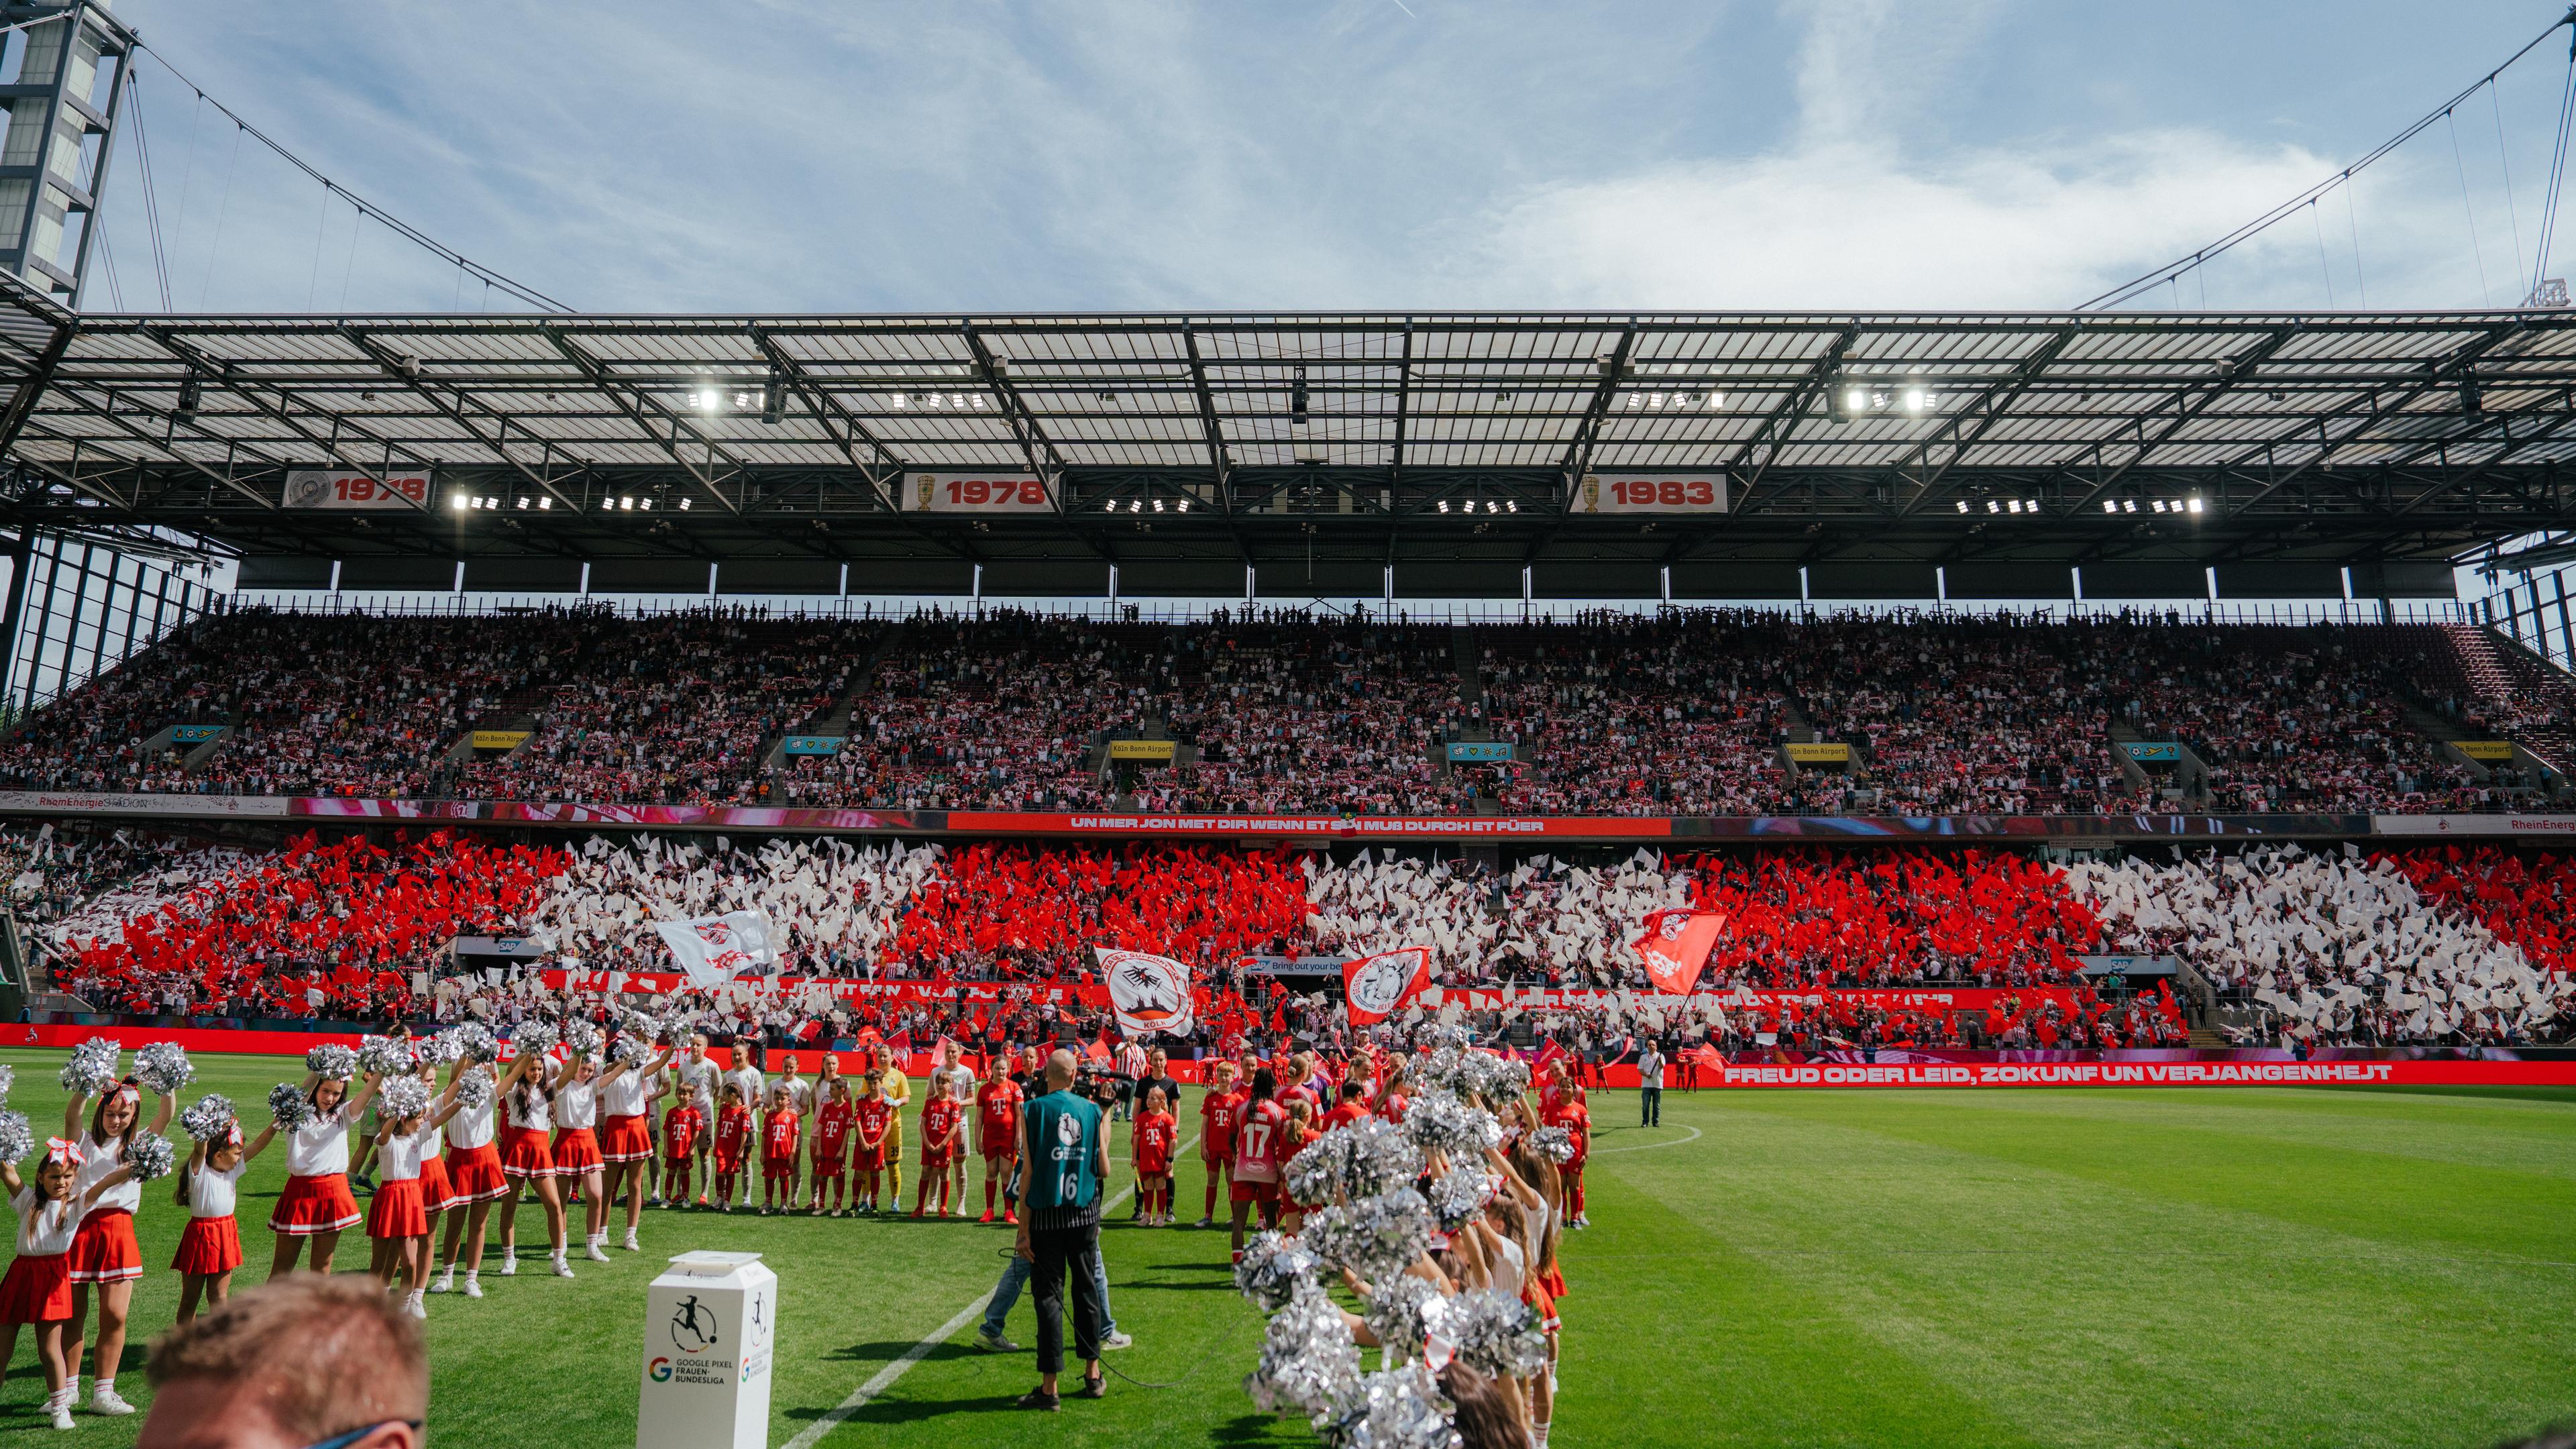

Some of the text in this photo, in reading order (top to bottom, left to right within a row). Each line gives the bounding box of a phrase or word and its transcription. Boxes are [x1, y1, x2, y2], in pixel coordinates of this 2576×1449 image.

[335, 478, 425, 500] 1978
[947, 481, 1046, 504] 1978
[1611, 482, 1714, 505] 1983
[1147, 745, 1173, 753] Airport
[1071, 818, 1097, 828] UN
[1099, 818, 1138, 828] MER
[1140, 818, 1176, 828] JON
[1178, 819, 1216, 829] MET
[1218, 819, 1248, 830] DIR
[1250, 820, 1304, 830] WENN
[1306, 820, 1329, 830] ET
[1330, 820, 1362, 830] SN
[1405, 821, 1470, 831] DURCH
[1472, 822, 1495, 831] ET
[1497, 819, 1544, 832] FÜER
[500, 942, 516, 951] SAP
[1250, 962, 1267, 970] SAP
[1273, 962, 1293, 971] Bring
[1310, 963, 1329, 971] your
[2112, 961, 2129, 969] SAP
[1144, 1019, 1167, 1029] KÖLN
[1725, 1065, 2393, 1085] FREUD ODER LEID, ZOKUNF UN VERJANGENHEJT
[706, 1134, 712, 1144] 5
[1244, 1123, 1271, 1158] 17
[890, 1146, 900, 1157] 39
[677, 1359, 710, 1367] GOOGLE
[676, 1367, 710, 1375] FRAUEN-
[676, 1375, 724, 1385] BUNDESLIGA
